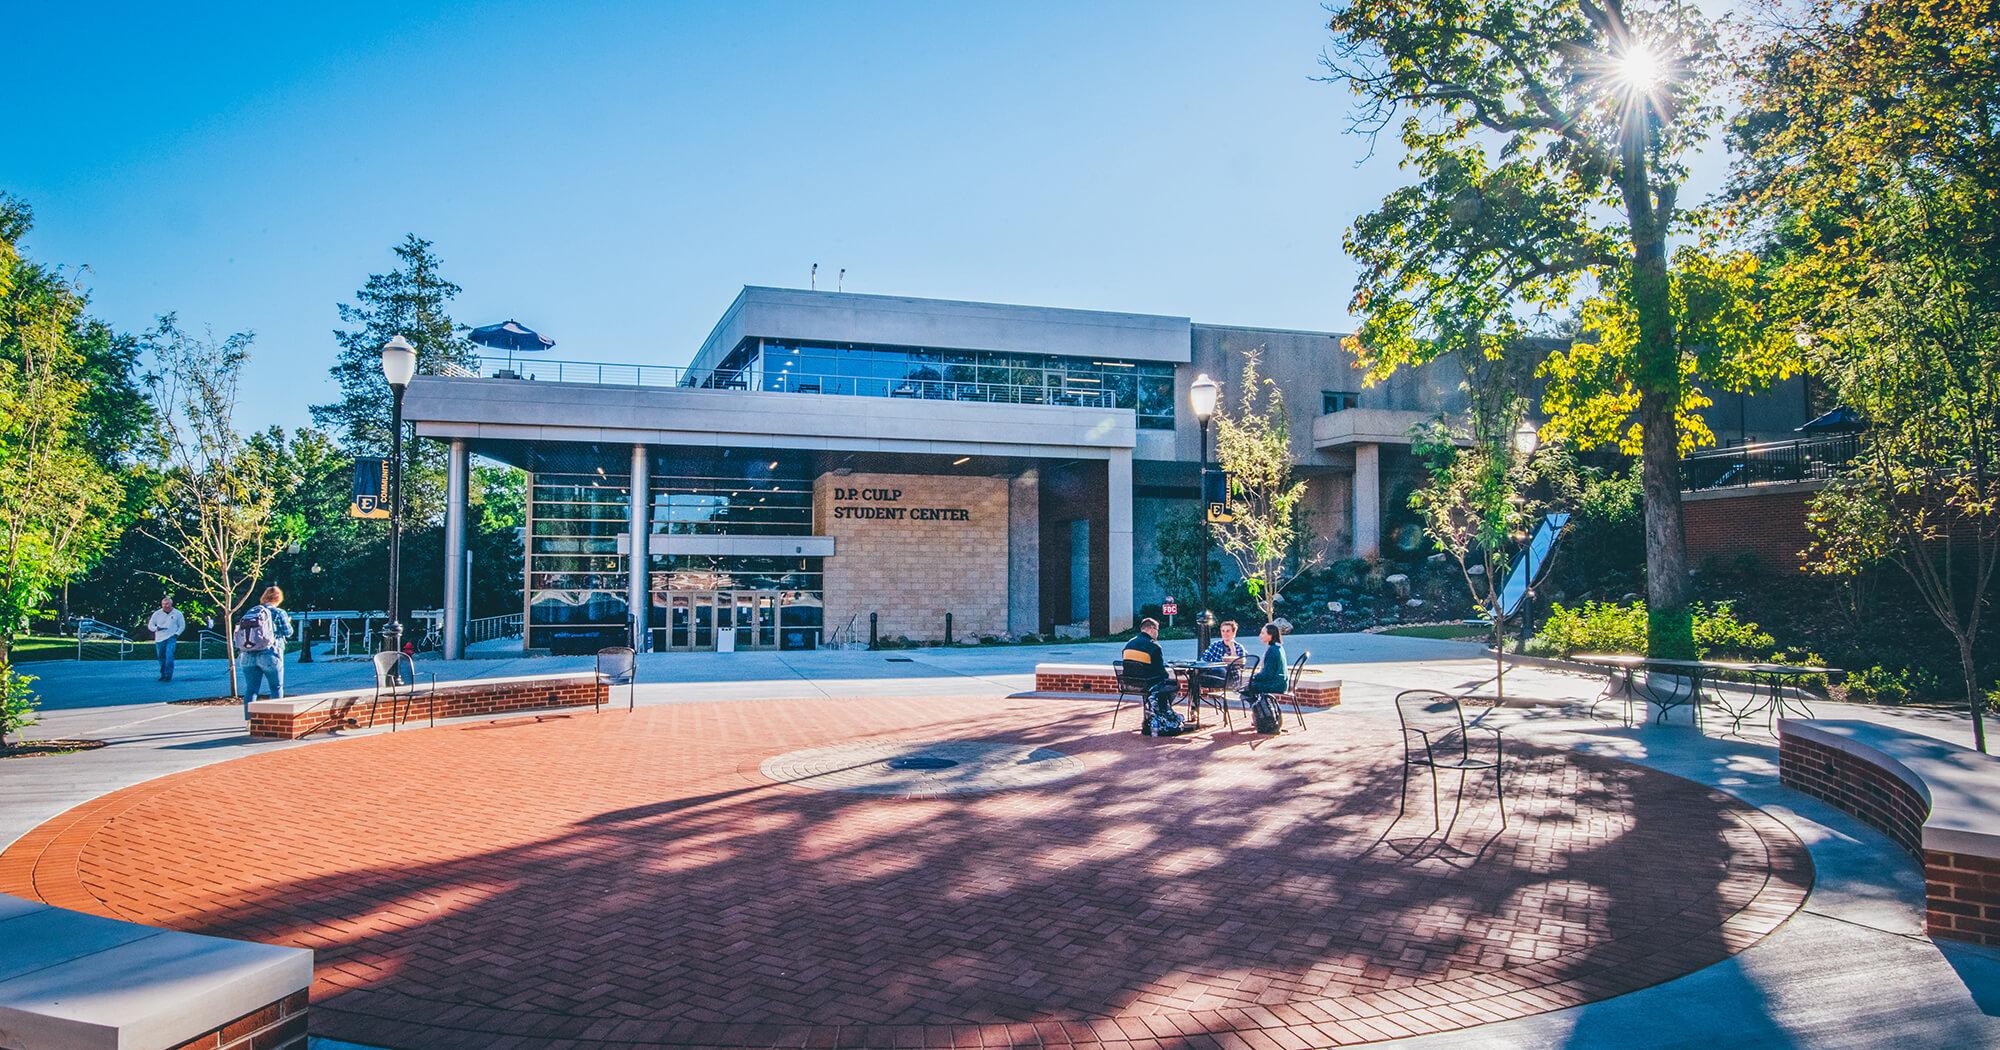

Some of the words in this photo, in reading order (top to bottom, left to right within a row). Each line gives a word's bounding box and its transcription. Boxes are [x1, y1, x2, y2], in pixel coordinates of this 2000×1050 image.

[380, 459, 389, 503] COMMUNITY
[834, 488, 858, 500] D.P.
[862, 489, 902, 501] CULP
[361, 498, 373, 510] E
[1213, 505, 1221, 515] E
[834, 507, 907, 520] STUDENT
[910, 508, 970, 521] CENTER
